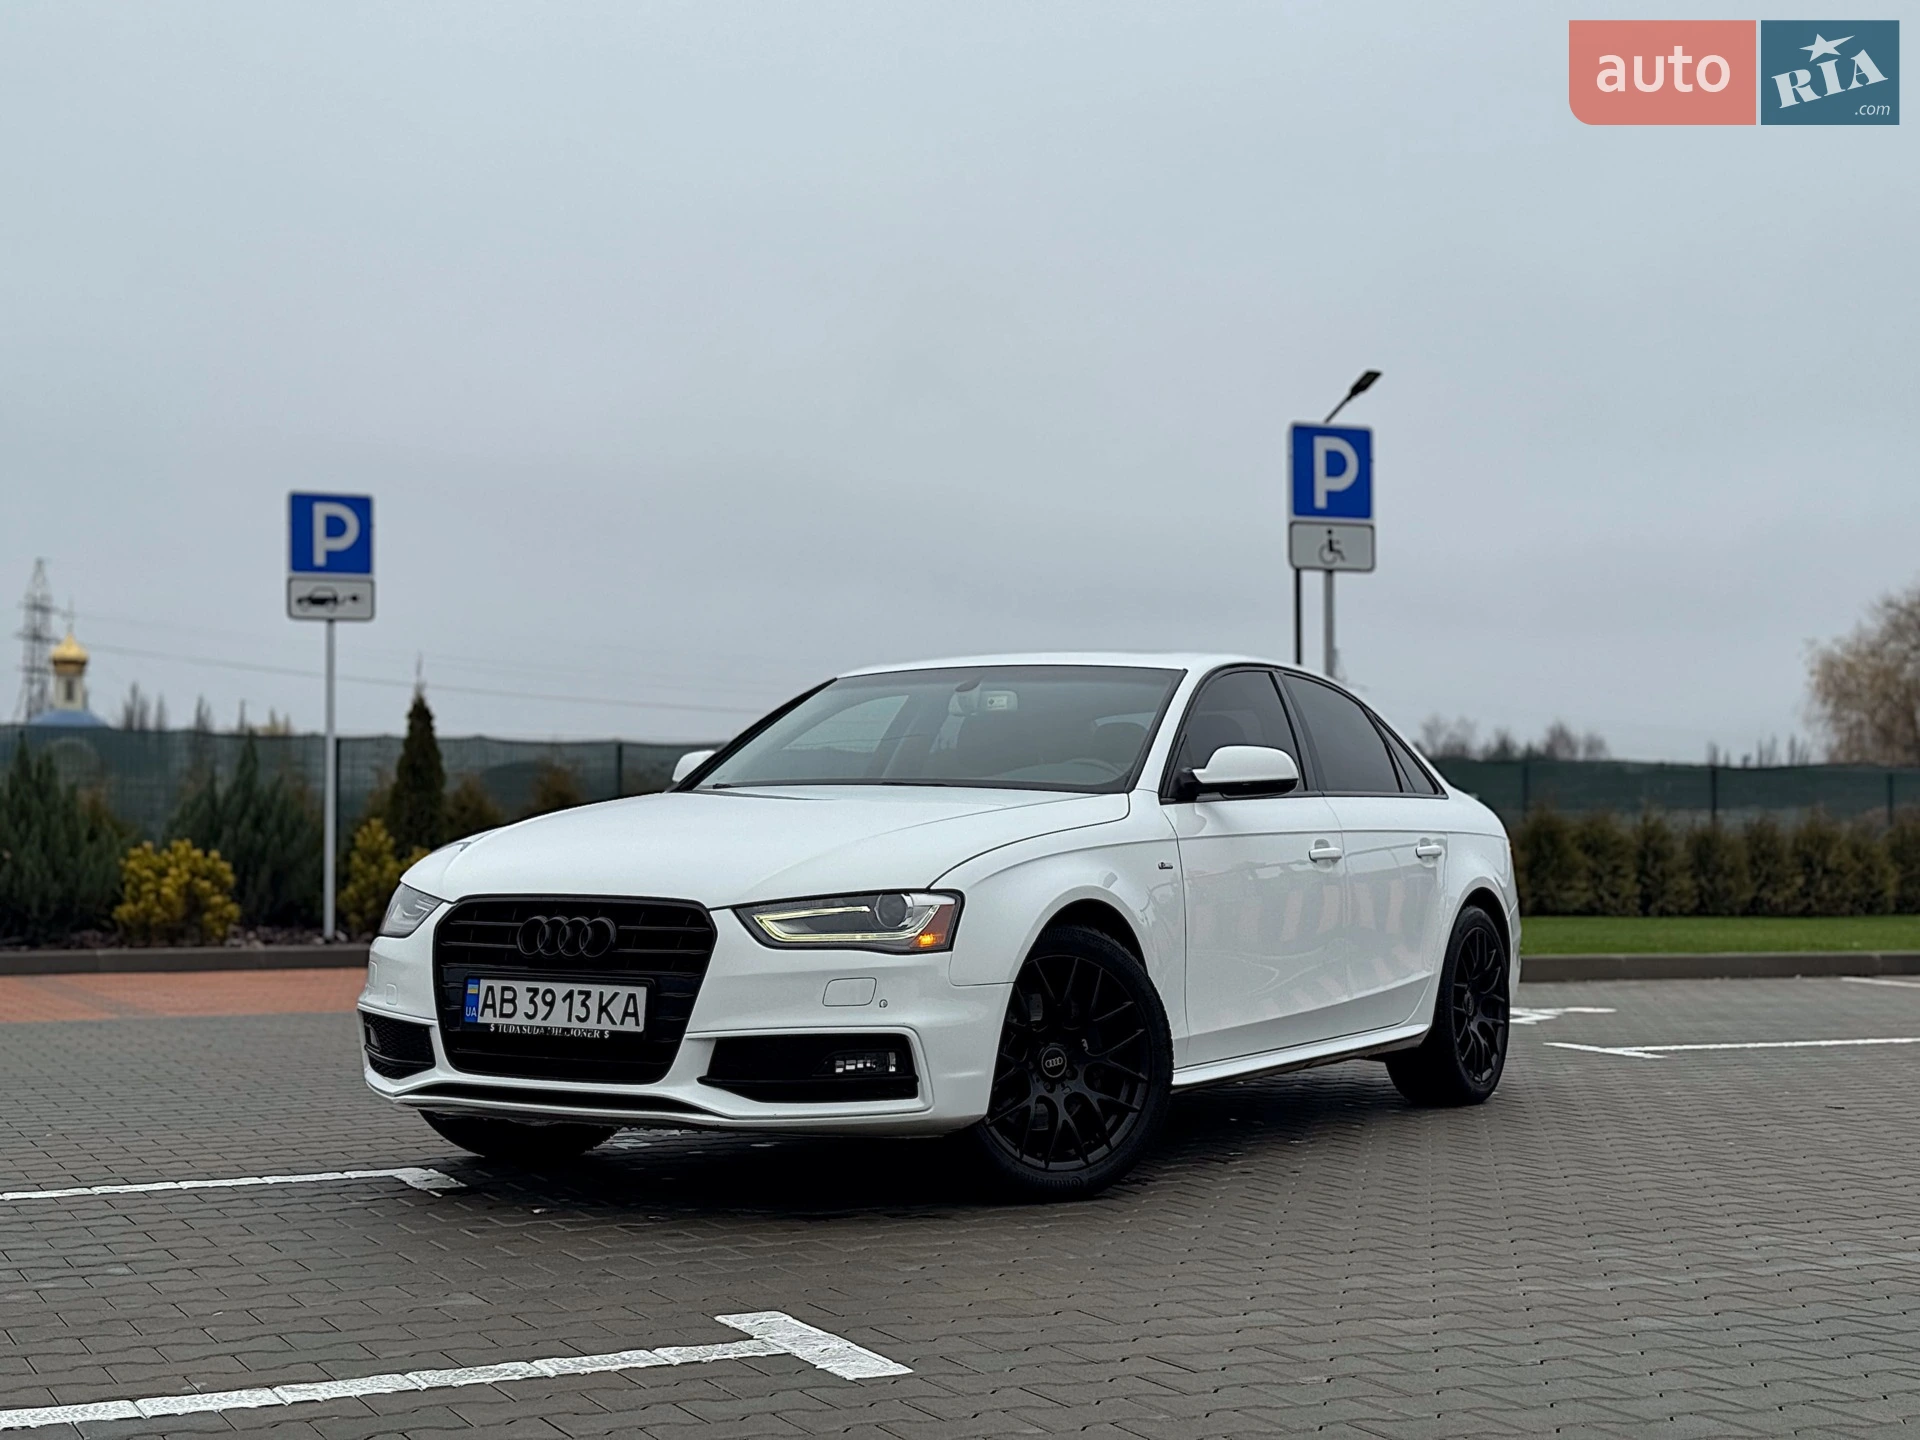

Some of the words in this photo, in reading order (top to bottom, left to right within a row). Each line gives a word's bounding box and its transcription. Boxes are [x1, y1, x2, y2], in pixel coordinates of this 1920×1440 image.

[1313, 435, 1359, 510] P
[312, 501, 360, 567] P
[465, 1006, 477, 1017] UA
[479, 985, 518, 1019] AB
[523, 987, 592, 1023] 3913
[596, 991, 641, 1027] KA
[497, 1023, 521, 1034] TUDA
[521, 1024, 545, 1036] SUDA
